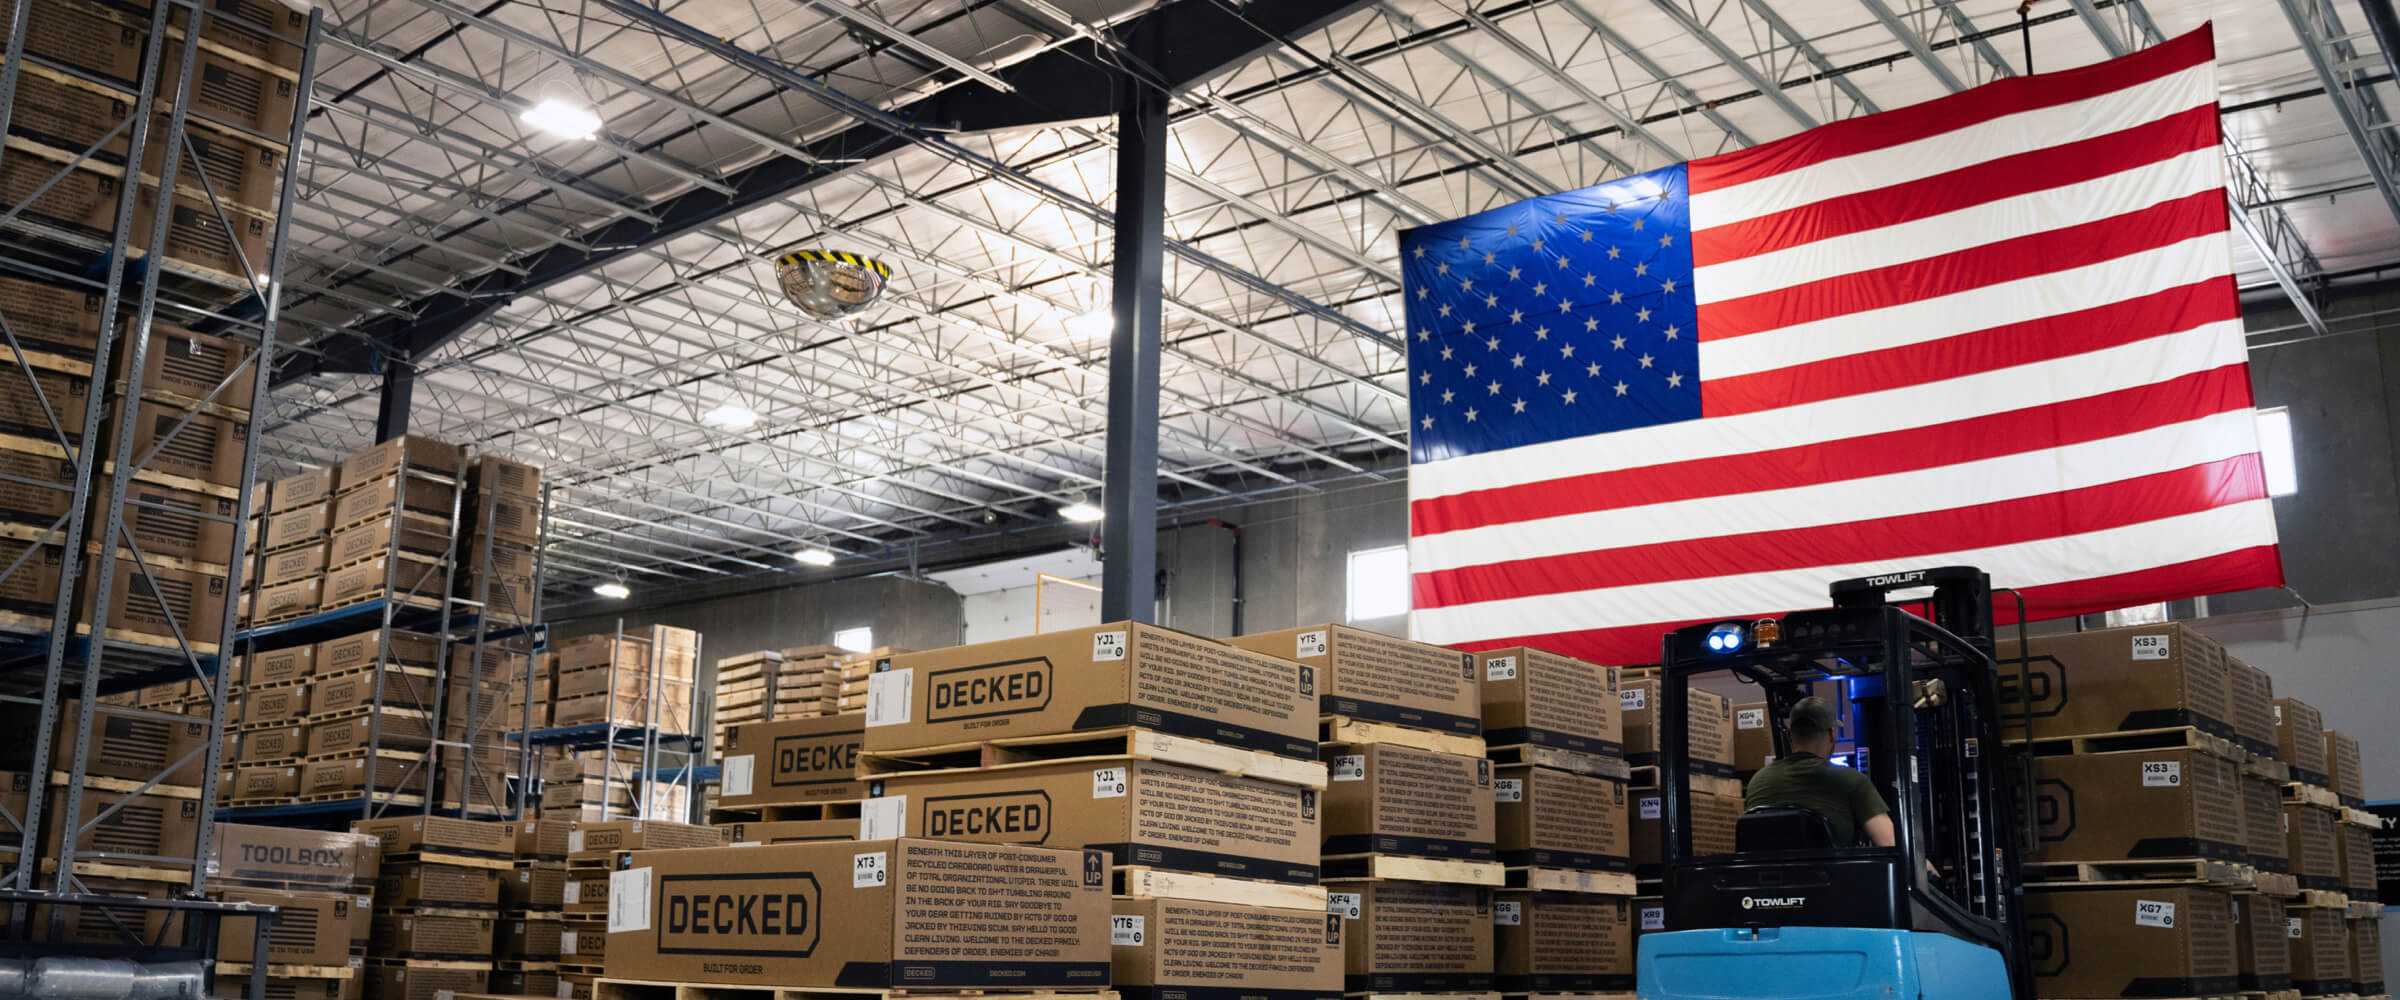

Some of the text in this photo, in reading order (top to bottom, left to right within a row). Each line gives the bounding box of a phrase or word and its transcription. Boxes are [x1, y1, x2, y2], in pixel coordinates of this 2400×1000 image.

[1866, 571, 1926, 586] TOWLIFT
[1097, 635, 1114, 646] YJ1
[936, 671, 1042, 709] DECKED
[780, 743, 859, 773] DECKE
[1335, 757, 1354, 767] XF4
[1097, 771, 1114, 781] YJ1
[932, 804, 1041, 836] DECKED
[589, 834, 619, 846] DECKED
[241, 844, 344, 868] TOOLBOX
[908, 847, 1056, 863] BENEATH THIS LAYER OF POST-CONSUMER
[857, 857, 875, 868] XT3
[907, 859, 946, 869] RECYCLED
[948, 862, 992, 871] CARDBOARD
[994, 864, 1018, 873] WAITS
[1026, 866, 1068, 875] DRAWERFUL
[907, 872, 917, 880] OF
[919, 872, 941, 881] TOTAL
[943, 874, 1008, 884] ORGANIZATIONAL
[1086, 872, 1101, 883] UP
[584, 884, 609, 897] DECK
[930, 885, 954, 894] GOING
[957, 886, 976, 895] BACK
[1006, 889, 1042, 898] TUMBLING
[1044, 891, 1071, 899] AROUND
[906, 897, 916, 905] IN
[918, 897, 932, 906] THE
[935, 898, 954, 906] BACK
[967, 899, 986, 907] YOUR
[1020, 901, 1052, 910] GOODBYE
[1330, 895, 1350, 904] XF4
[1754, 897, 1805, 907] TOWLIFT
[670, 894, 808, 935] DECKED
[2140, 903, 2161, 914] XG7
[906, 910, 926, 918] YOUR
[950, 911, 983, 919] GETTING
[984, 912, 1012, 920] RUINED
[905, 922, 935, 930] JACKED
[937, 922, 947, 930] BY
[949, 923, 986, 932] THIEVING
[1113, 918, 1132, 928] YT6
[905, 934, 930, 943] CLEAN
[963, 936, 1000, 944] WELCOME
[905, 947, 950, 955] DEFENDERS
[990, 948, 1023, 956] ENEMIES
[704, 963, 763, 975] BUILT FOR ORDER
